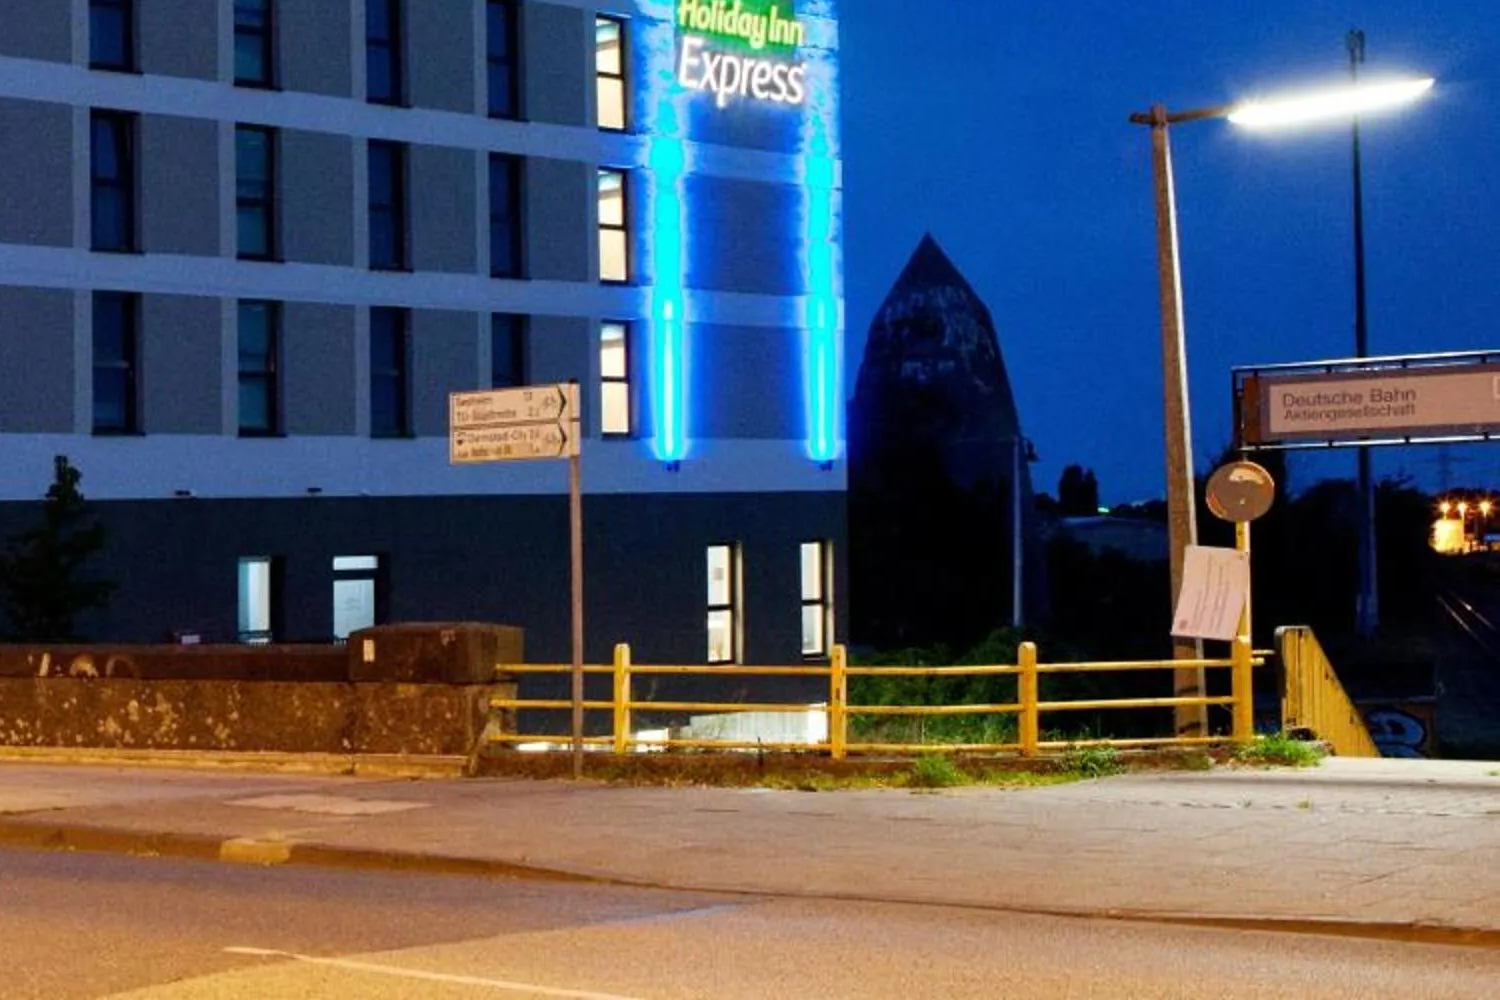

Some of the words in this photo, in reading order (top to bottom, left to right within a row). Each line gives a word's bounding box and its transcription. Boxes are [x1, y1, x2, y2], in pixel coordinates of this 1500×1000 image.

[766, 4, 805, 45] Inn
[678, 34, 808, 109] Express
[1282, 391, 1363, 408] Deutsche
[1369, 387, 1417, 403] Bahn
[1283, 403, 1416, 421] Aktiengesellschaft
